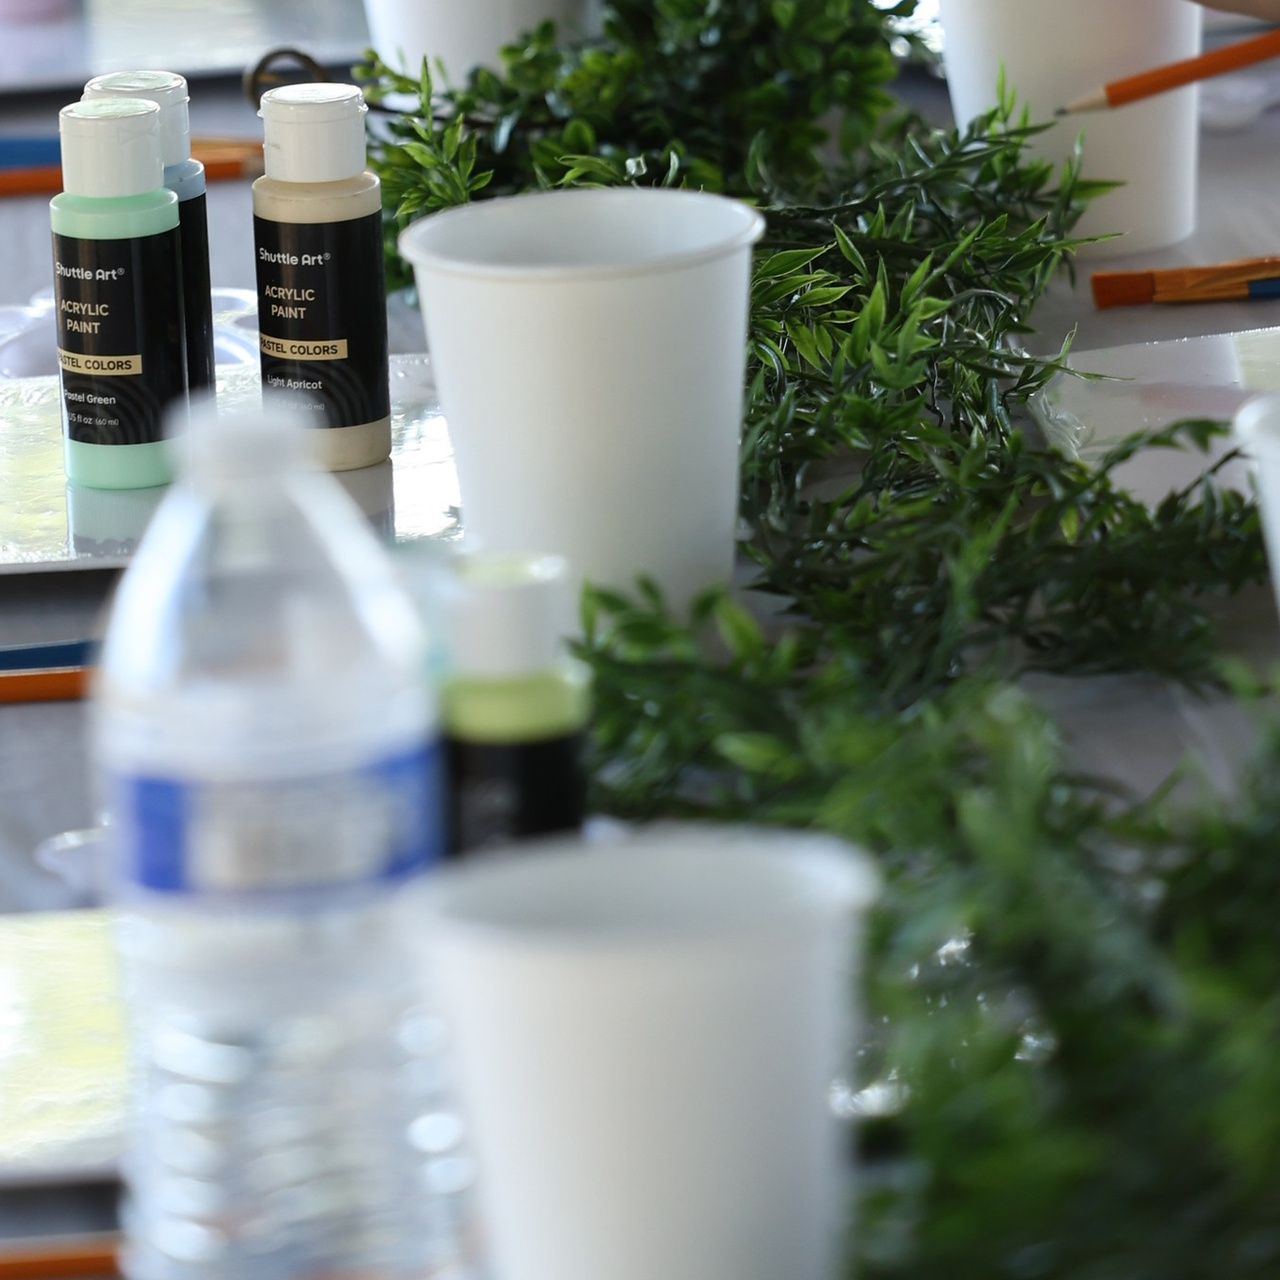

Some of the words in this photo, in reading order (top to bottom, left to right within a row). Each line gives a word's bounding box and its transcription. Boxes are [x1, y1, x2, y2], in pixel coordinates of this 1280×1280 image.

[259, 247, 299, 266] Shuttle
[55, 261, 93, 280] Shuttle
[264, 284, 316, 302] ACRYLIC
[60, 299, 109, 316] ACRYLIC
[271, 304, 307, 320] PAINT
[66, 318, 101, 334] PAINT
[289, 344, 338, 356] COLORS
[84, 359, 133, 371] COLORS
[267, 374, 285, 388] Light
[286, 378, 323, 390] Apricot
[86, 394, 116, 405] Green
[83, 416, 93, 425] oz
